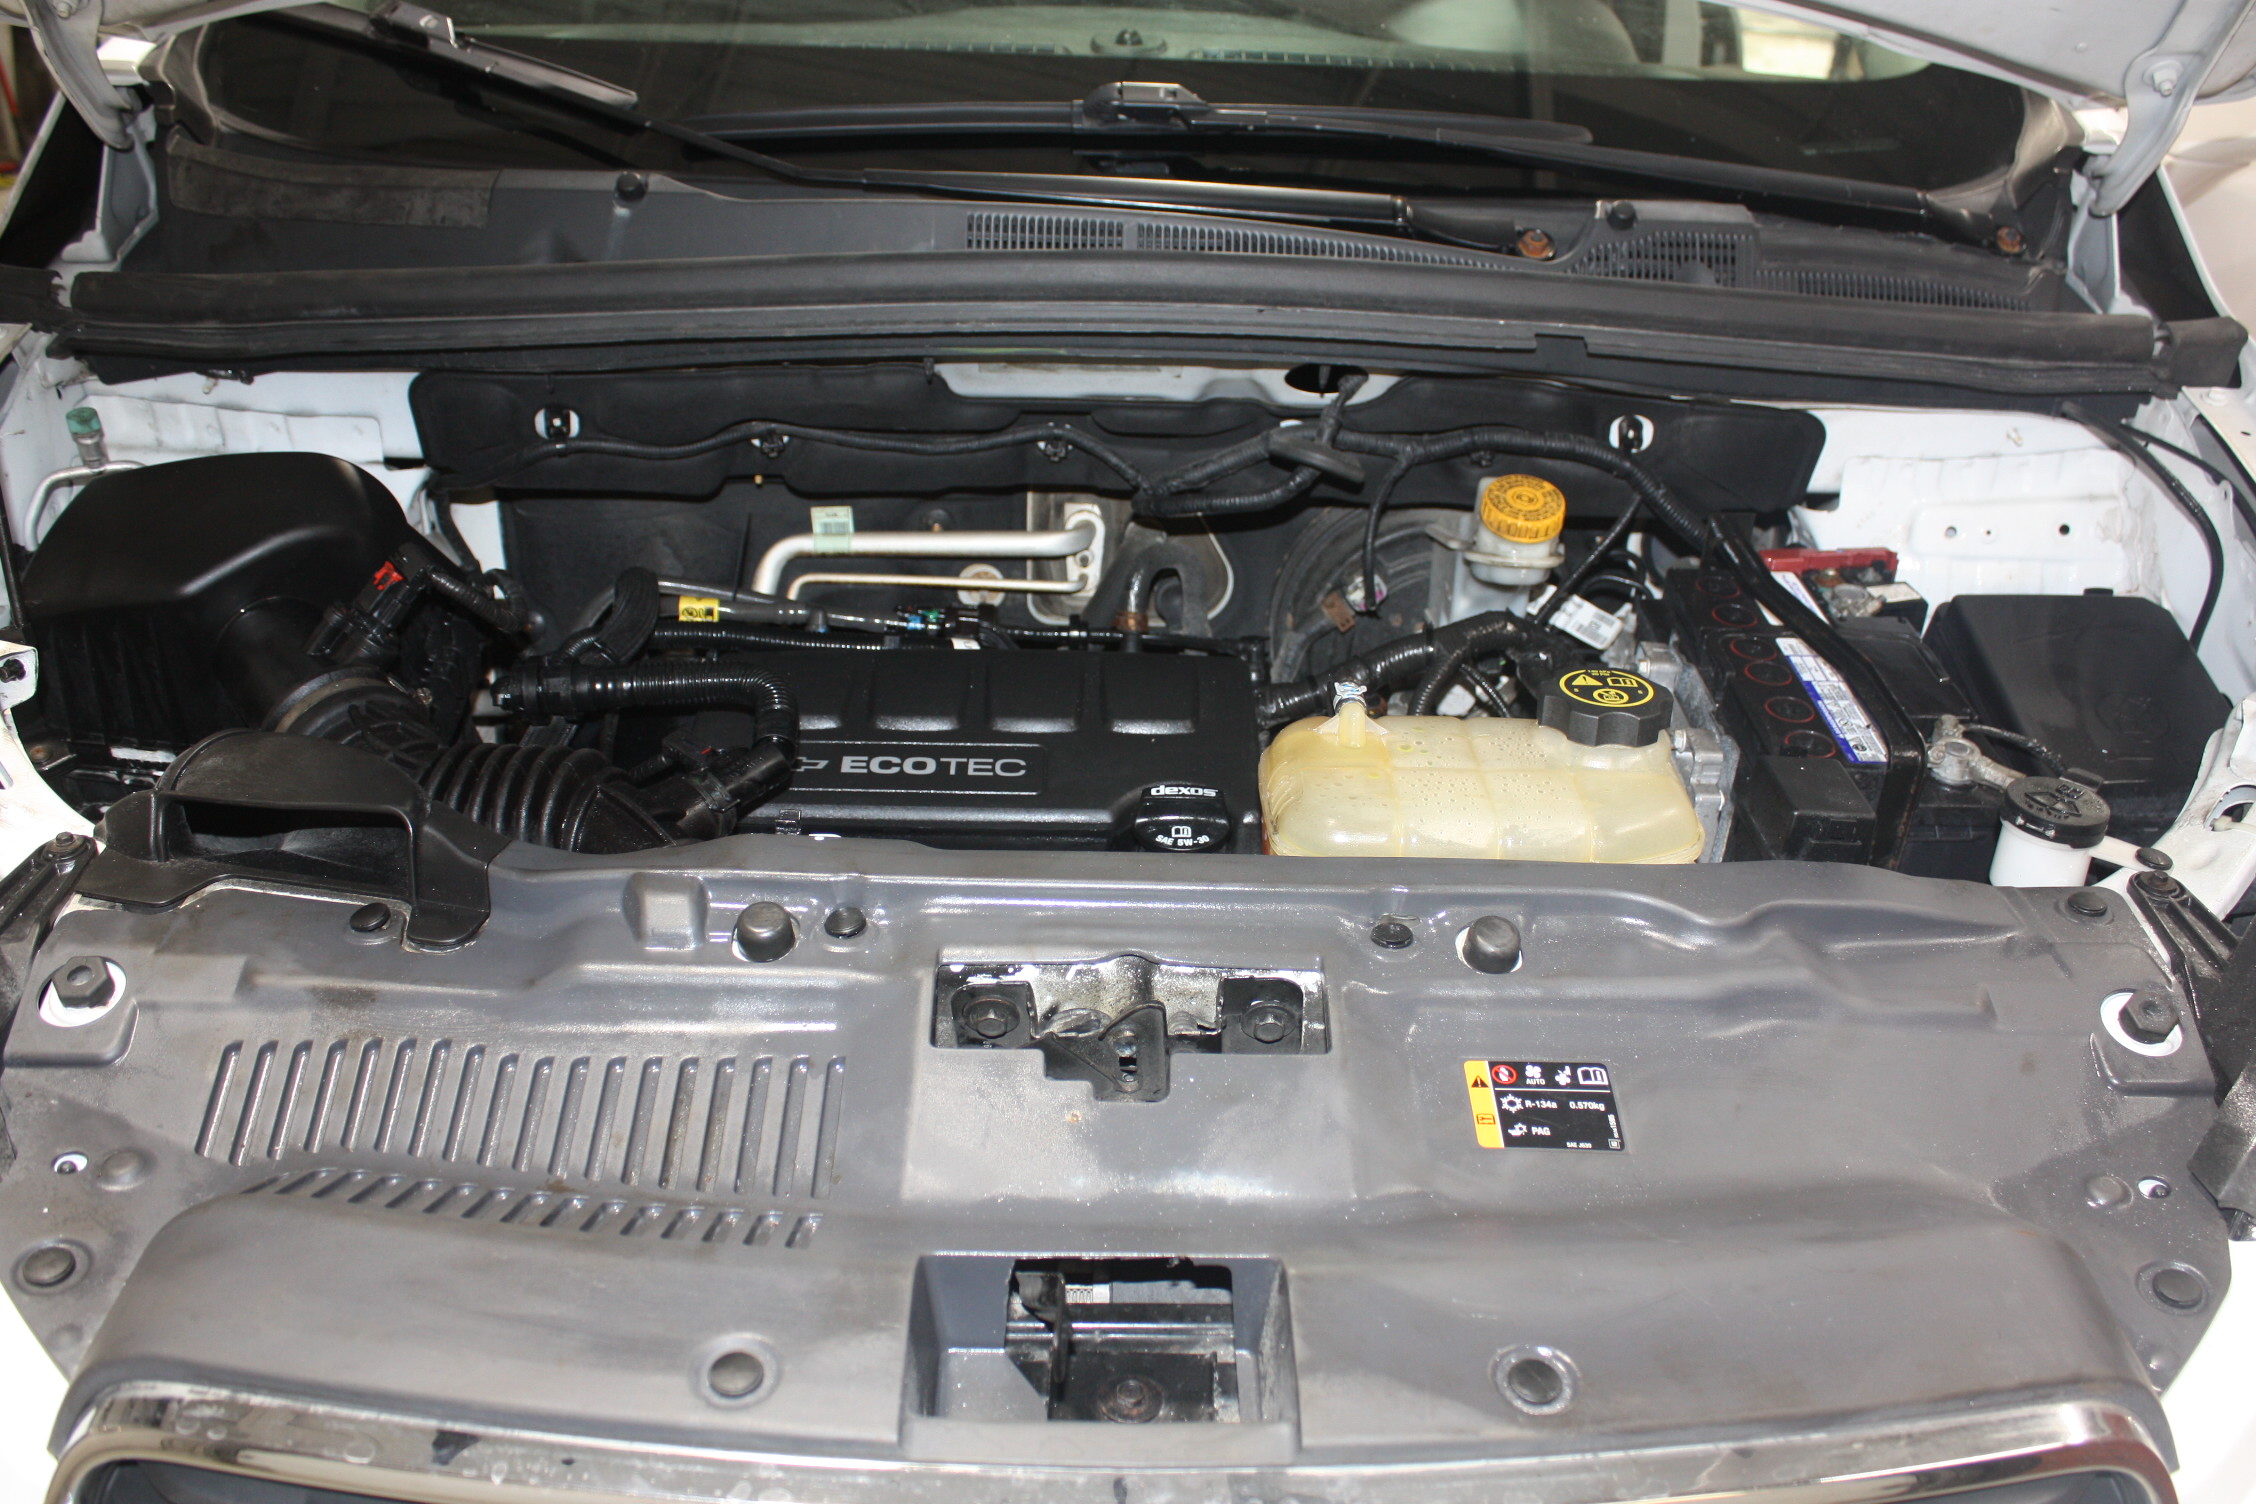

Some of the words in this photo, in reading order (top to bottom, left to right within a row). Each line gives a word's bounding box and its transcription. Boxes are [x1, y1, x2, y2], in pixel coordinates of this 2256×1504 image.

[840, 755, 1027, 777] ECOTEC
[1150, 784, 1219, 797] dexos
[1155, 834, 1175, 846] SAE
[1177, 834, 1210, 847] 5W-30
[1525, 1078, 1546, 1086] AUTO
[1525, 1099, 1558, 1109] R-134a
[1569, 1101, 1606, 1112] 0.570kg
[1531, 1126, 1551, 1136] PAG
